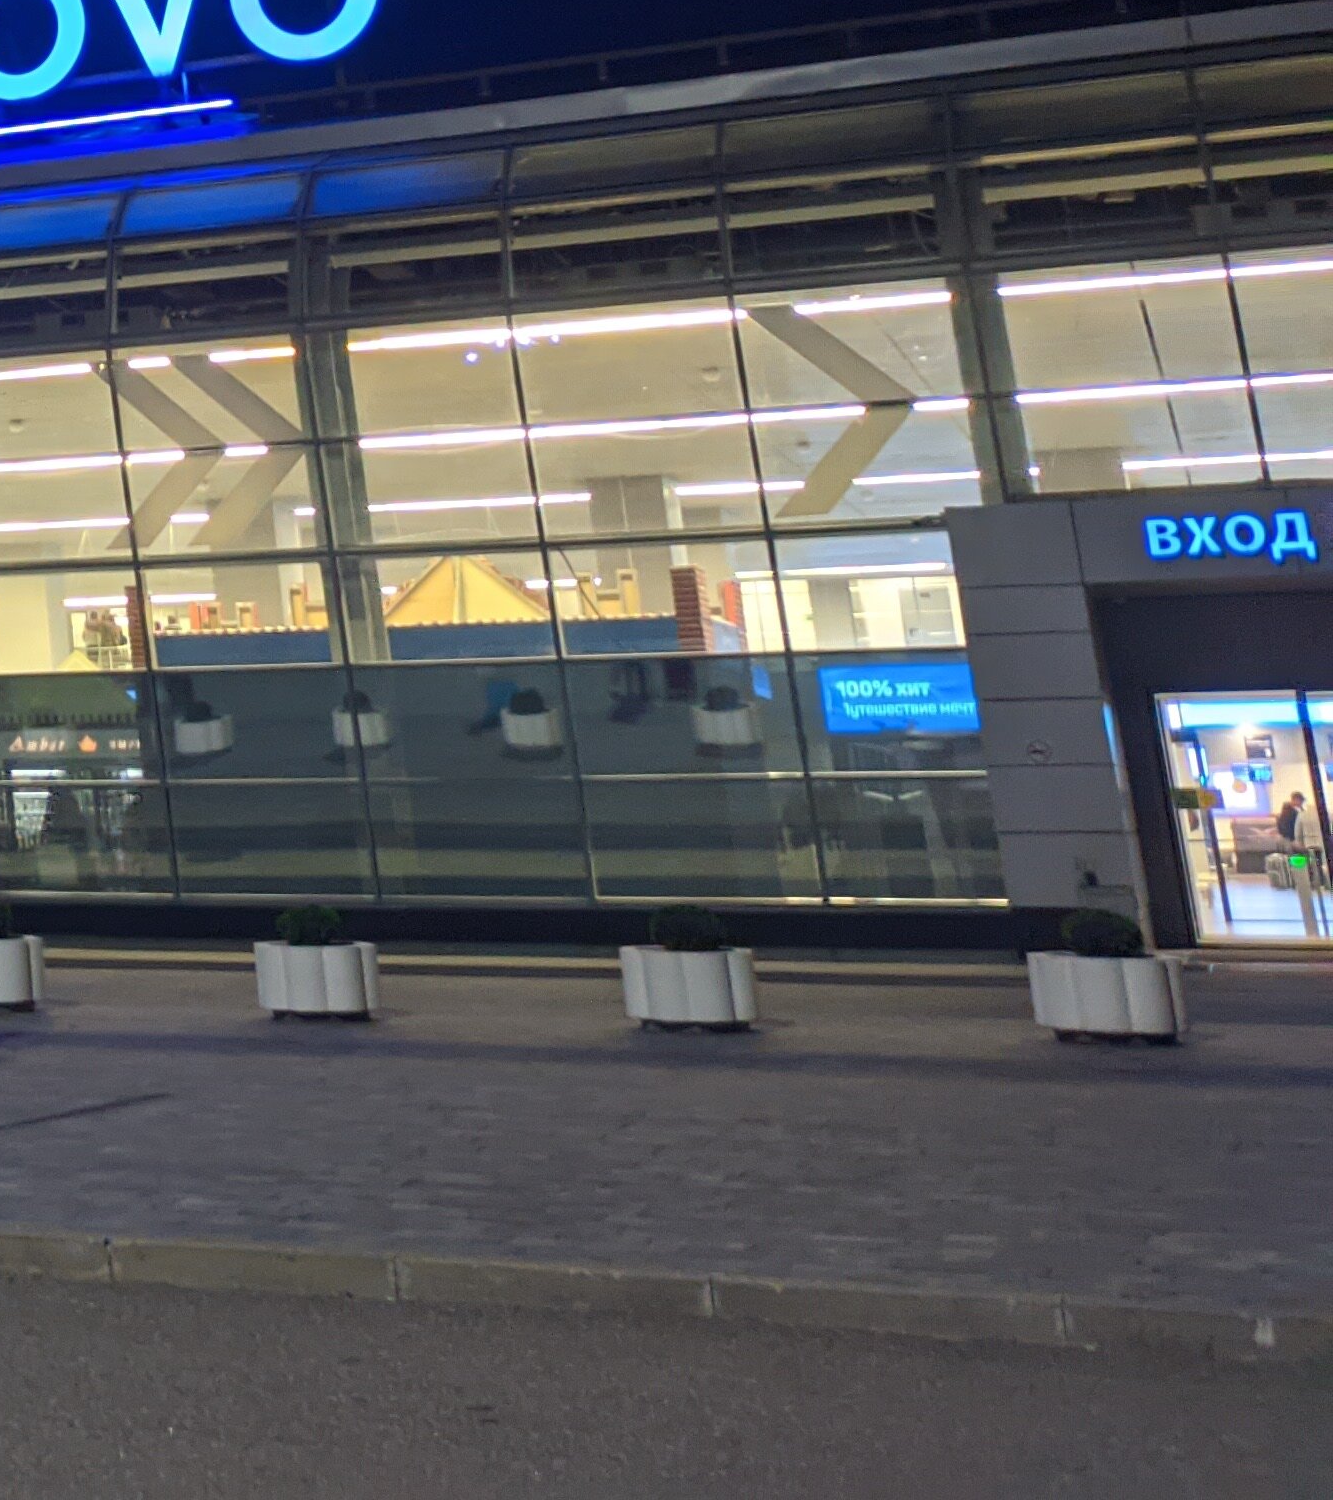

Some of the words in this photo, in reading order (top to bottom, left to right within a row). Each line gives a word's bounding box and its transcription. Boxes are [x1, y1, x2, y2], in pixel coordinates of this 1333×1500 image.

[1145, 511, 1318, 561] ВХОД
[836, 679, 893, 698] 100%
[895, 682, 931, 697] хит
